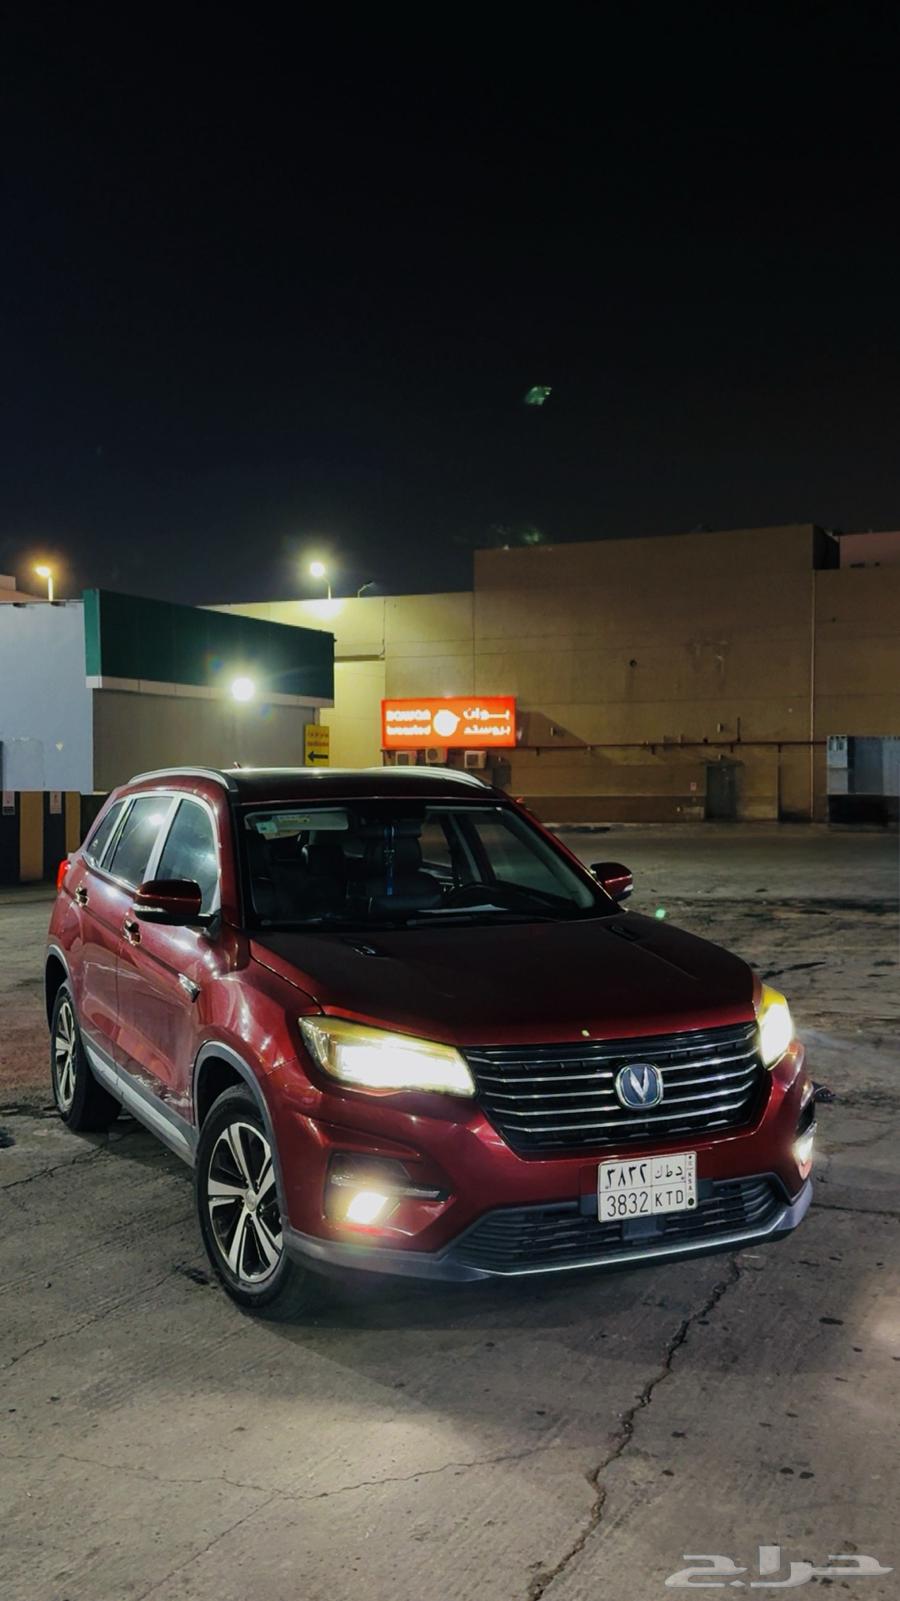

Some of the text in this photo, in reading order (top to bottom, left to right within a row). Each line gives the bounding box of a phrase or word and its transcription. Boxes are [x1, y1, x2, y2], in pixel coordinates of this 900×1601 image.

[607, 1163, 647, 1188] ٣٨٣٢
[607, 1191, 649, 1217] 3832
[655, 1189, 684, 1208] KTD
